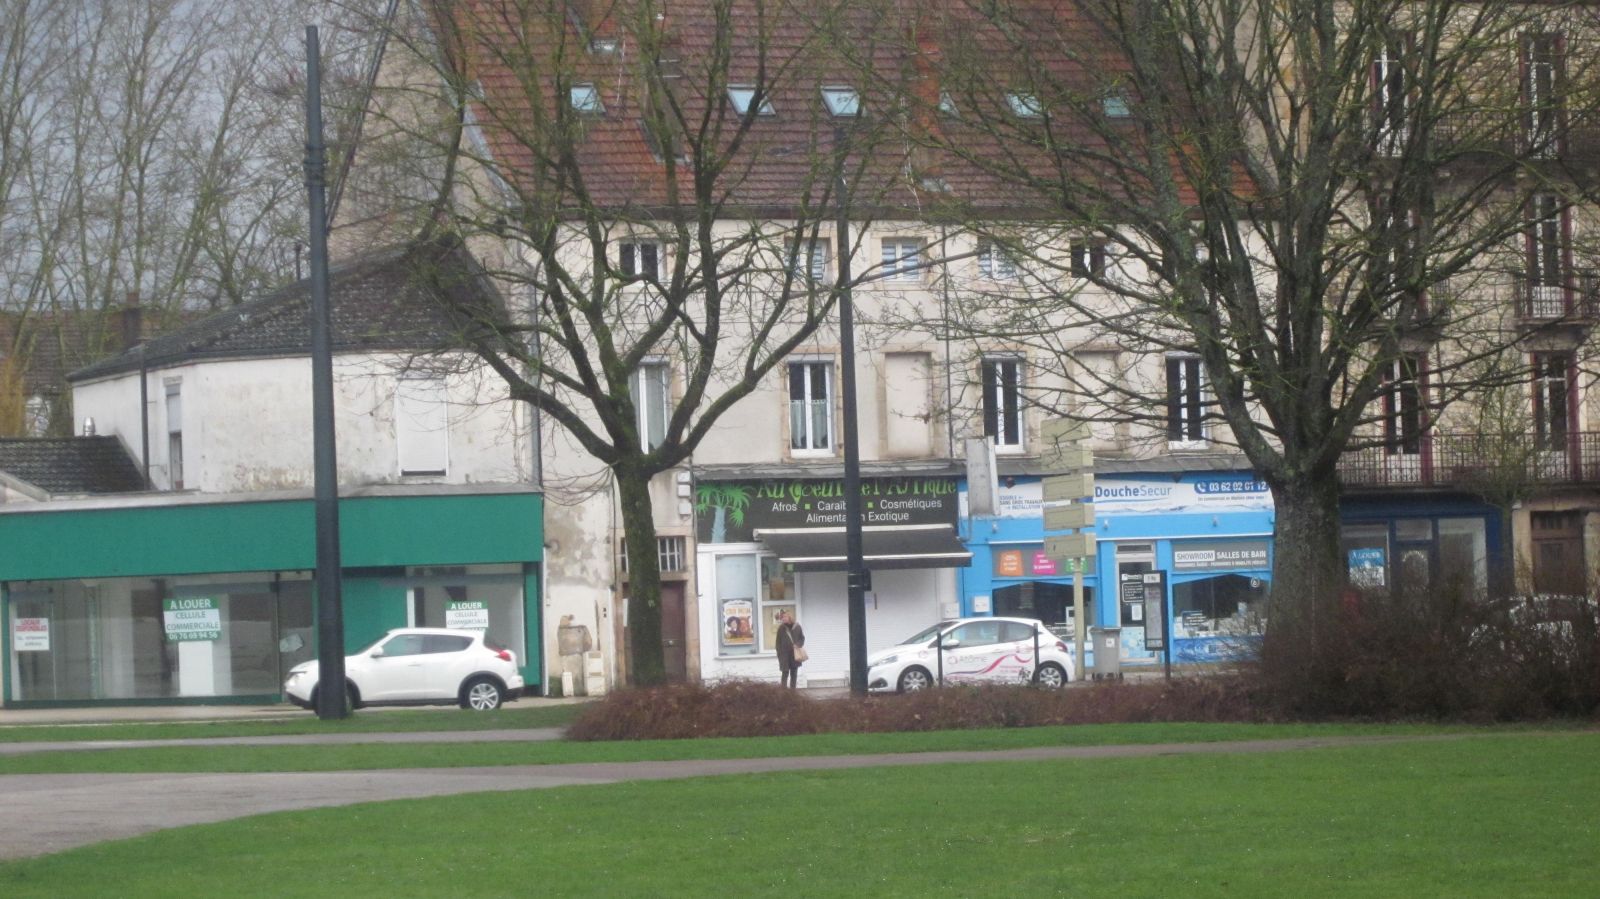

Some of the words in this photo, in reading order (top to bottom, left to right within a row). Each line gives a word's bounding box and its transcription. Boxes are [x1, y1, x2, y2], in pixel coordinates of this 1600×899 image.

[757, 482, 785, 498] Au
[1095, 485, 1172, 498] DoucheSecur
[1209, 482, 1220, 492] 03
[1220, 482, 1231, 492] 62
[1232, 481, 1243, 491] 02
[771, 502, 798, 512] Afros
[880, 499, 942, 510] Cosmétiques
[868, 511, 909, 523] Exotique
[1176, 552, 1214, 561] SHOWROOM
[1216, 551, 1240, 559] SALLES
[1251, 550, 1266, 558] BAIN
[170, 600, 177, 609] A
[179, 599, 211, 609] LOUER
[458, 601, 482, 609] LOUER
[176, 611, 207, 619] CELLULE
[167, 621, 219, 631] COMMERCIALE
